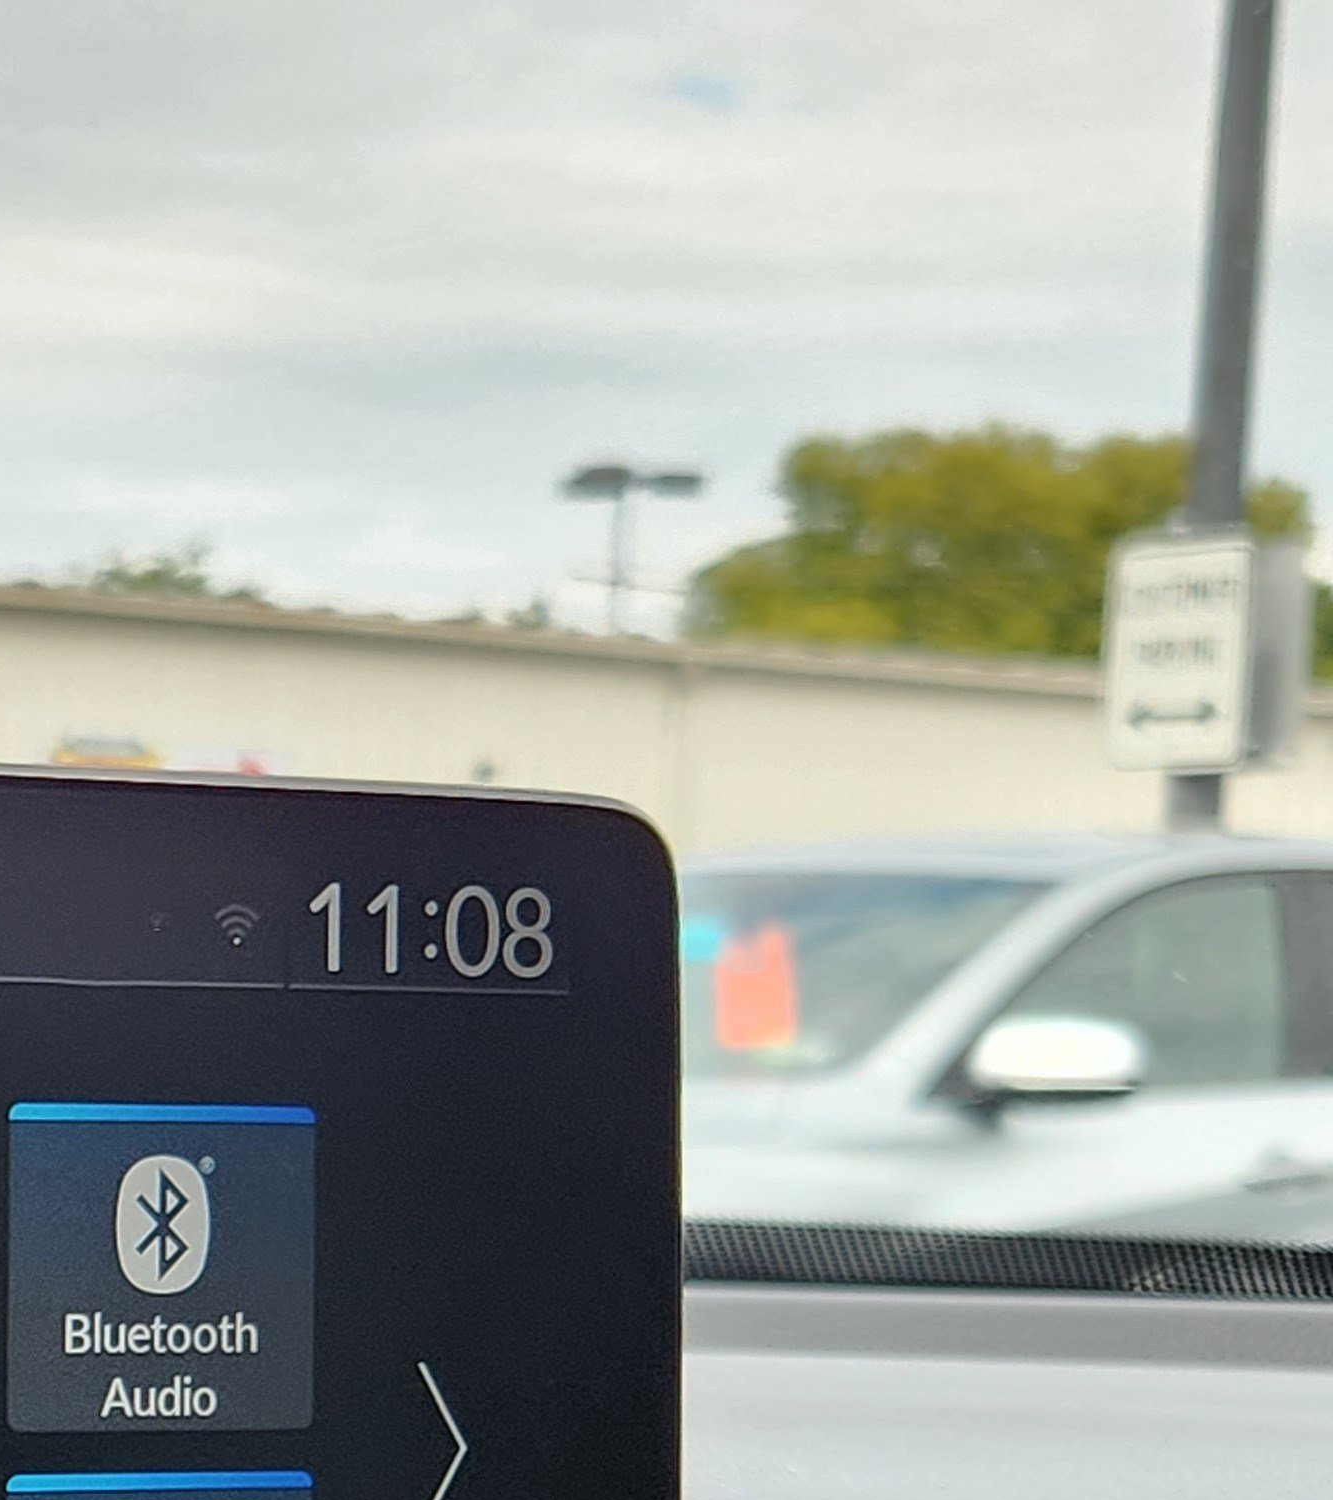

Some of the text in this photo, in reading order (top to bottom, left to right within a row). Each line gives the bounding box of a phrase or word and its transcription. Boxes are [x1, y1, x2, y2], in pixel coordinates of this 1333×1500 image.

[309, 881, 554, 979] 11:08
[63, 1310, 259, 1355] Bluetooth
[99, 1374, 218, 1418] Audio
